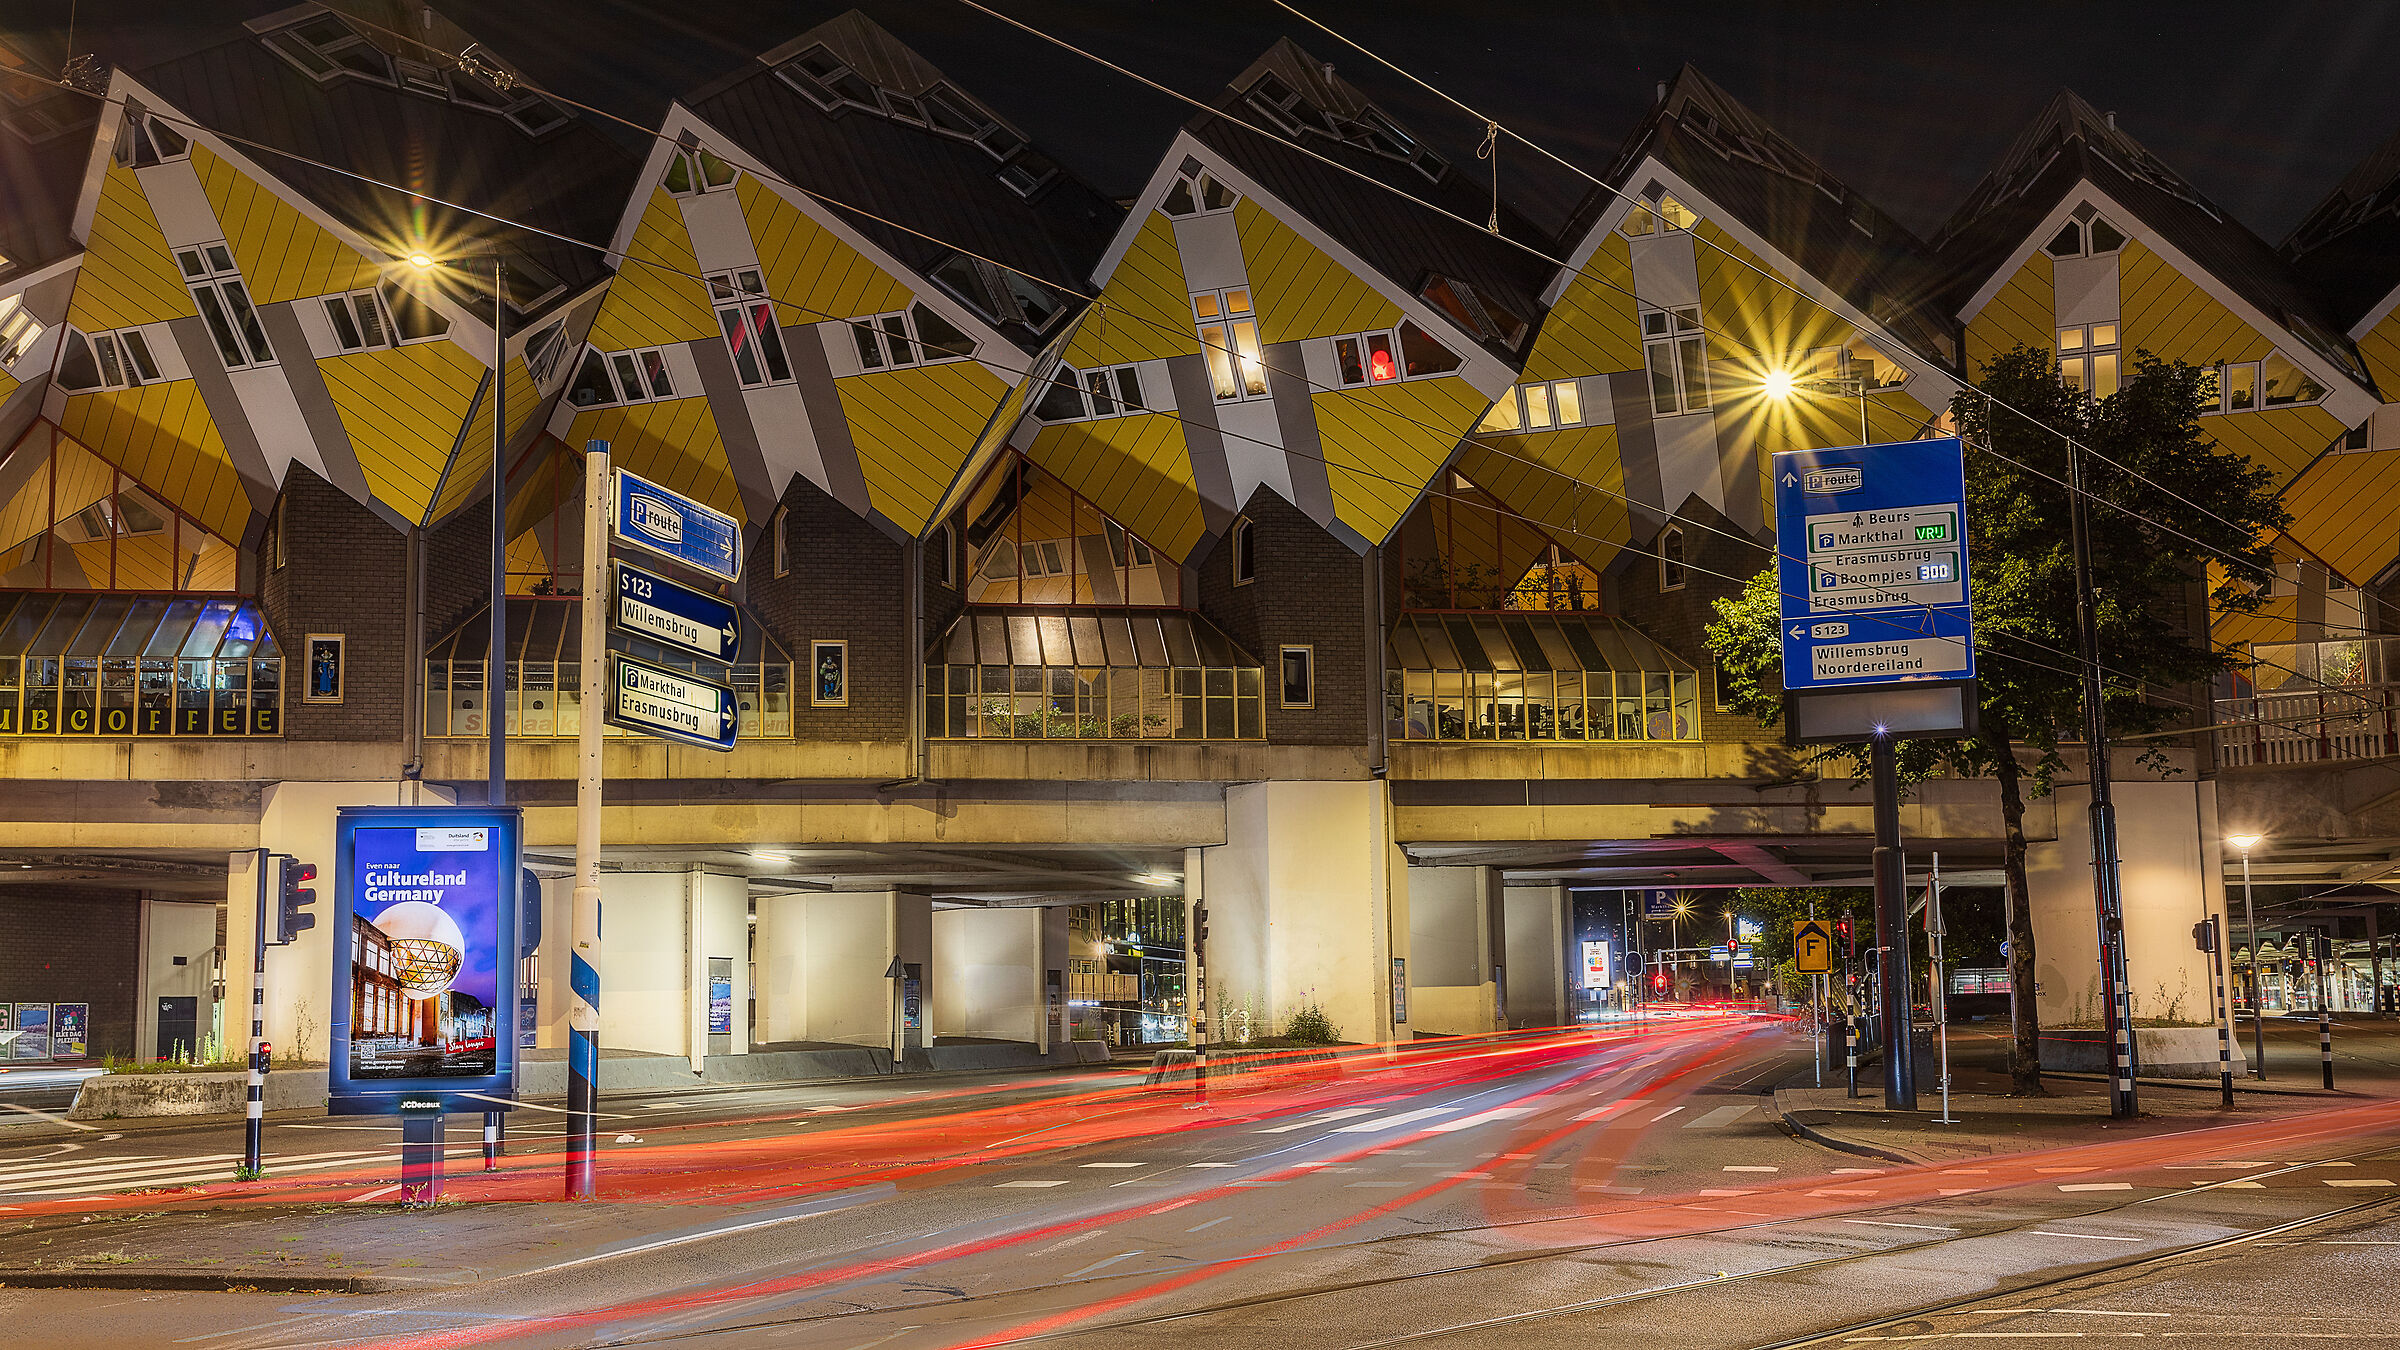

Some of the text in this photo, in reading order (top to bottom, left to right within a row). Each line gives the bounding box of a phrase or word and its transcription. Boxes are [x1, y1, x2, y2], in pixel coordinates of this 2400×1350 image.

[1825, 473, 1858, 486] route
[636, 502, 679, 535] P route
[1869, 512, 1911, 525] Beurs
[1839, 529, 1904, 545] Markthal
[1836, 550, 1931, 566] Erasmusbrug
[1841, 569, 1912, 584] Boompjes
[1920, 564, 1948, 580] 300
[621, 573, 653, 599] S 123
[1814, 592, 1909, 608] Erasmusbrug
[624, 600, 698, 644] Willemsbrug
[1814, 625, 1846, 636] S 123
[1816, 645, 1909, 660] Willemsbrug
[1817, 657, 1923, 675] Noordereiland
[640, 674, 686, 699] Markthal
[621, 693, 699, 732] Erasmusbrug
[366, 862, 401, 870] Even naar
[365, 870, 467, 886] Cultureland
[364, 886, 445, 905] Germany
[1656, 890, 1667, 905] P
[1806, 939, 1820, 957] F
[448, 1039, 485, 1051] Stay longer
[401, 1100, 441, 1109] JCDecaux
